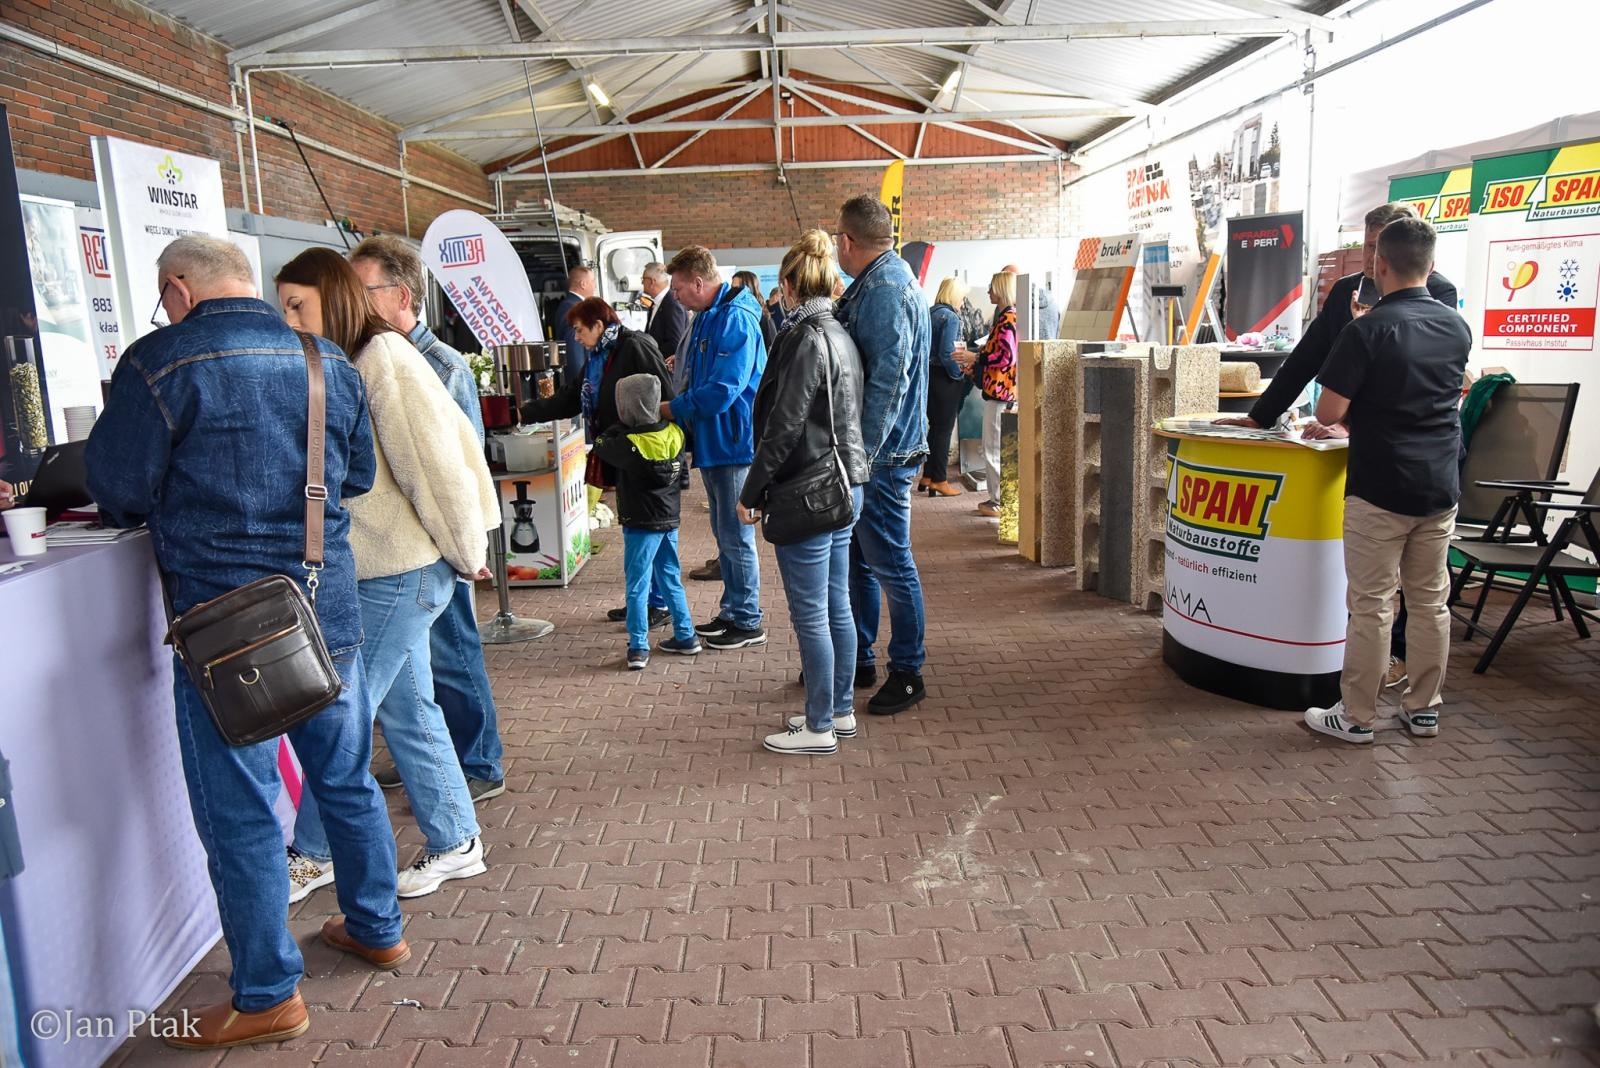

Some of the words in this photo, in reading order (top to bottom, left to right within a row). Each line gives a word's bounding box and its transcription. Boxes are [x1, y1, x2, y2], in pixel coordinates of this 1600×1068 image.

[147, 186, 199, 210] WINSTAR
[1444, 197, 1471, 219] SPA
[1490, 185, 1526, 209] ISO
[1100, 241, 1121, 257] bruk
[92, 298, 113, 312] 883
[1498, 324, 1578, 333] COMPONENT
[1506, 313, 1570, 323] CERTIFIED
[1180, 475, 1260, 526] SPAN
[1169, 519, 1260, 556] Naturbaustoffe
[1177, 555, 1209, 574] natürlich
[1212, 566, 1257, 583] effizient
